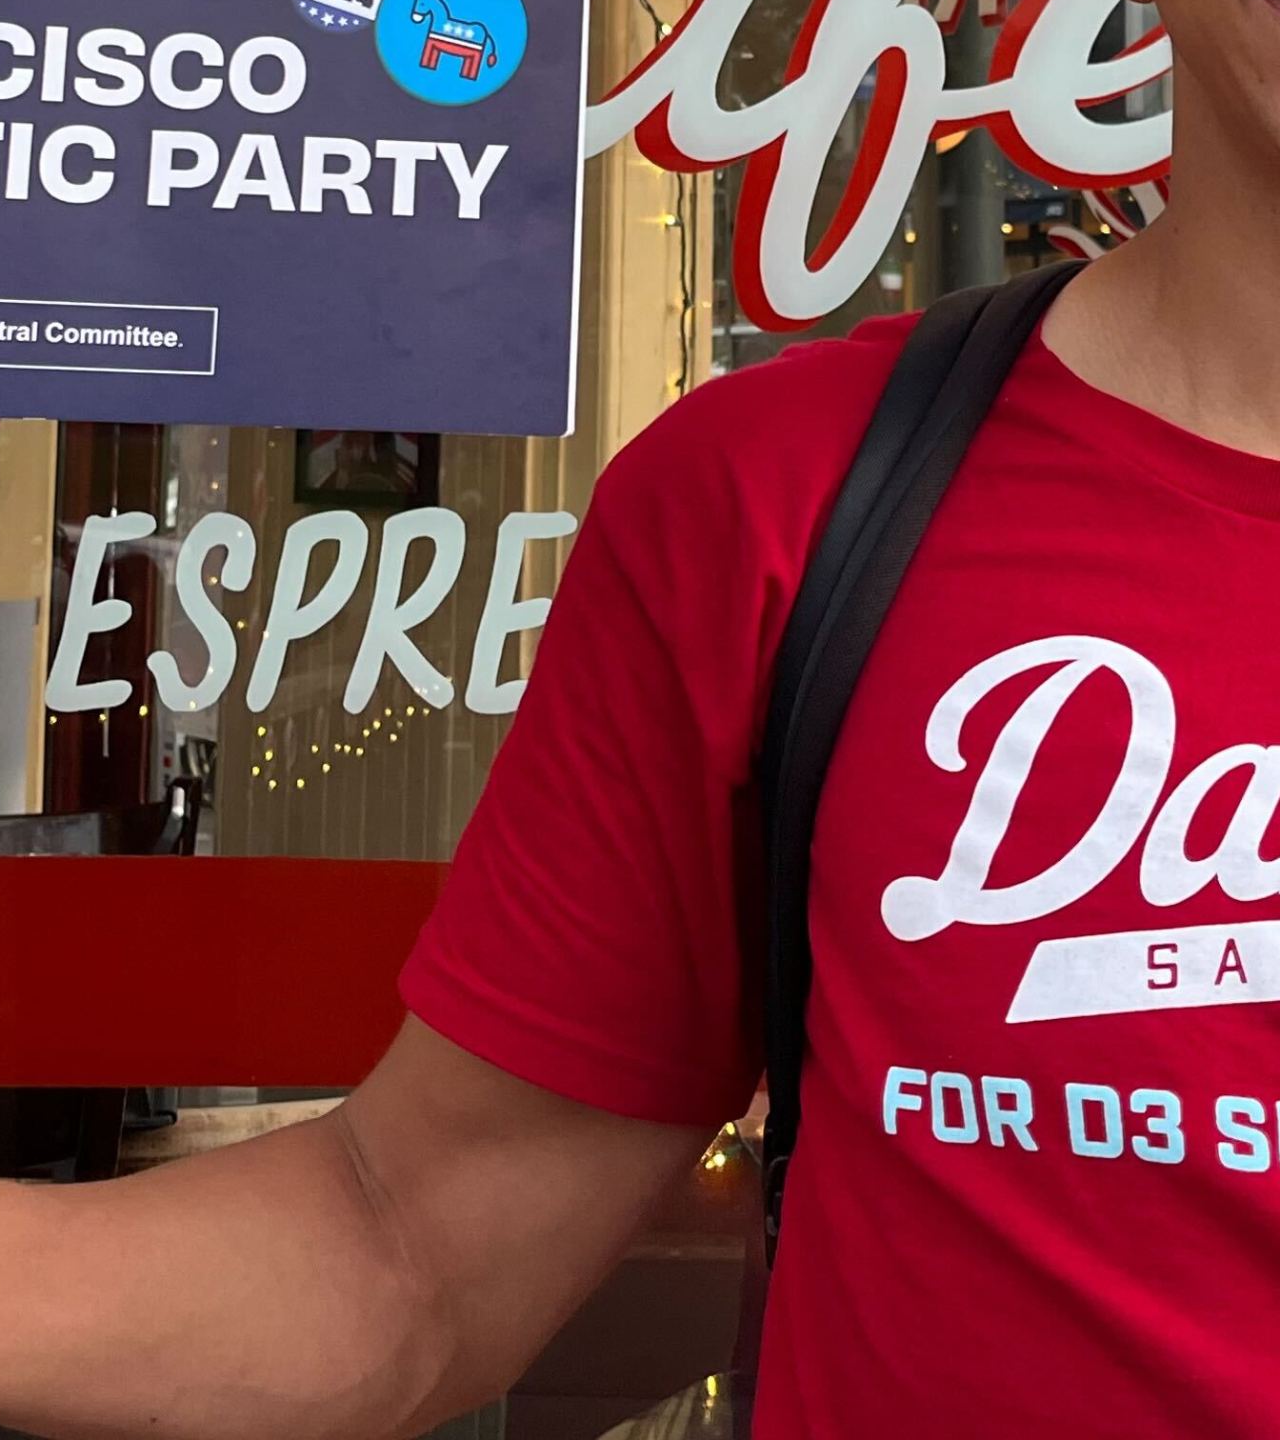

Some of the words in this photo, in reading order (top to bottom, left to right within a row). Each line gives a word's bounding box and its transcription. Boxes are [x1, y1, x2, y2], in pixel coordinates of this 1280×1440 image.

[146, 129, 510, 221] PARTY
[44, 321, 184, 349] Committee.
[882, 1064, 1036, 1154] FOR
[1066, 1084, 1184, 1165] D3
